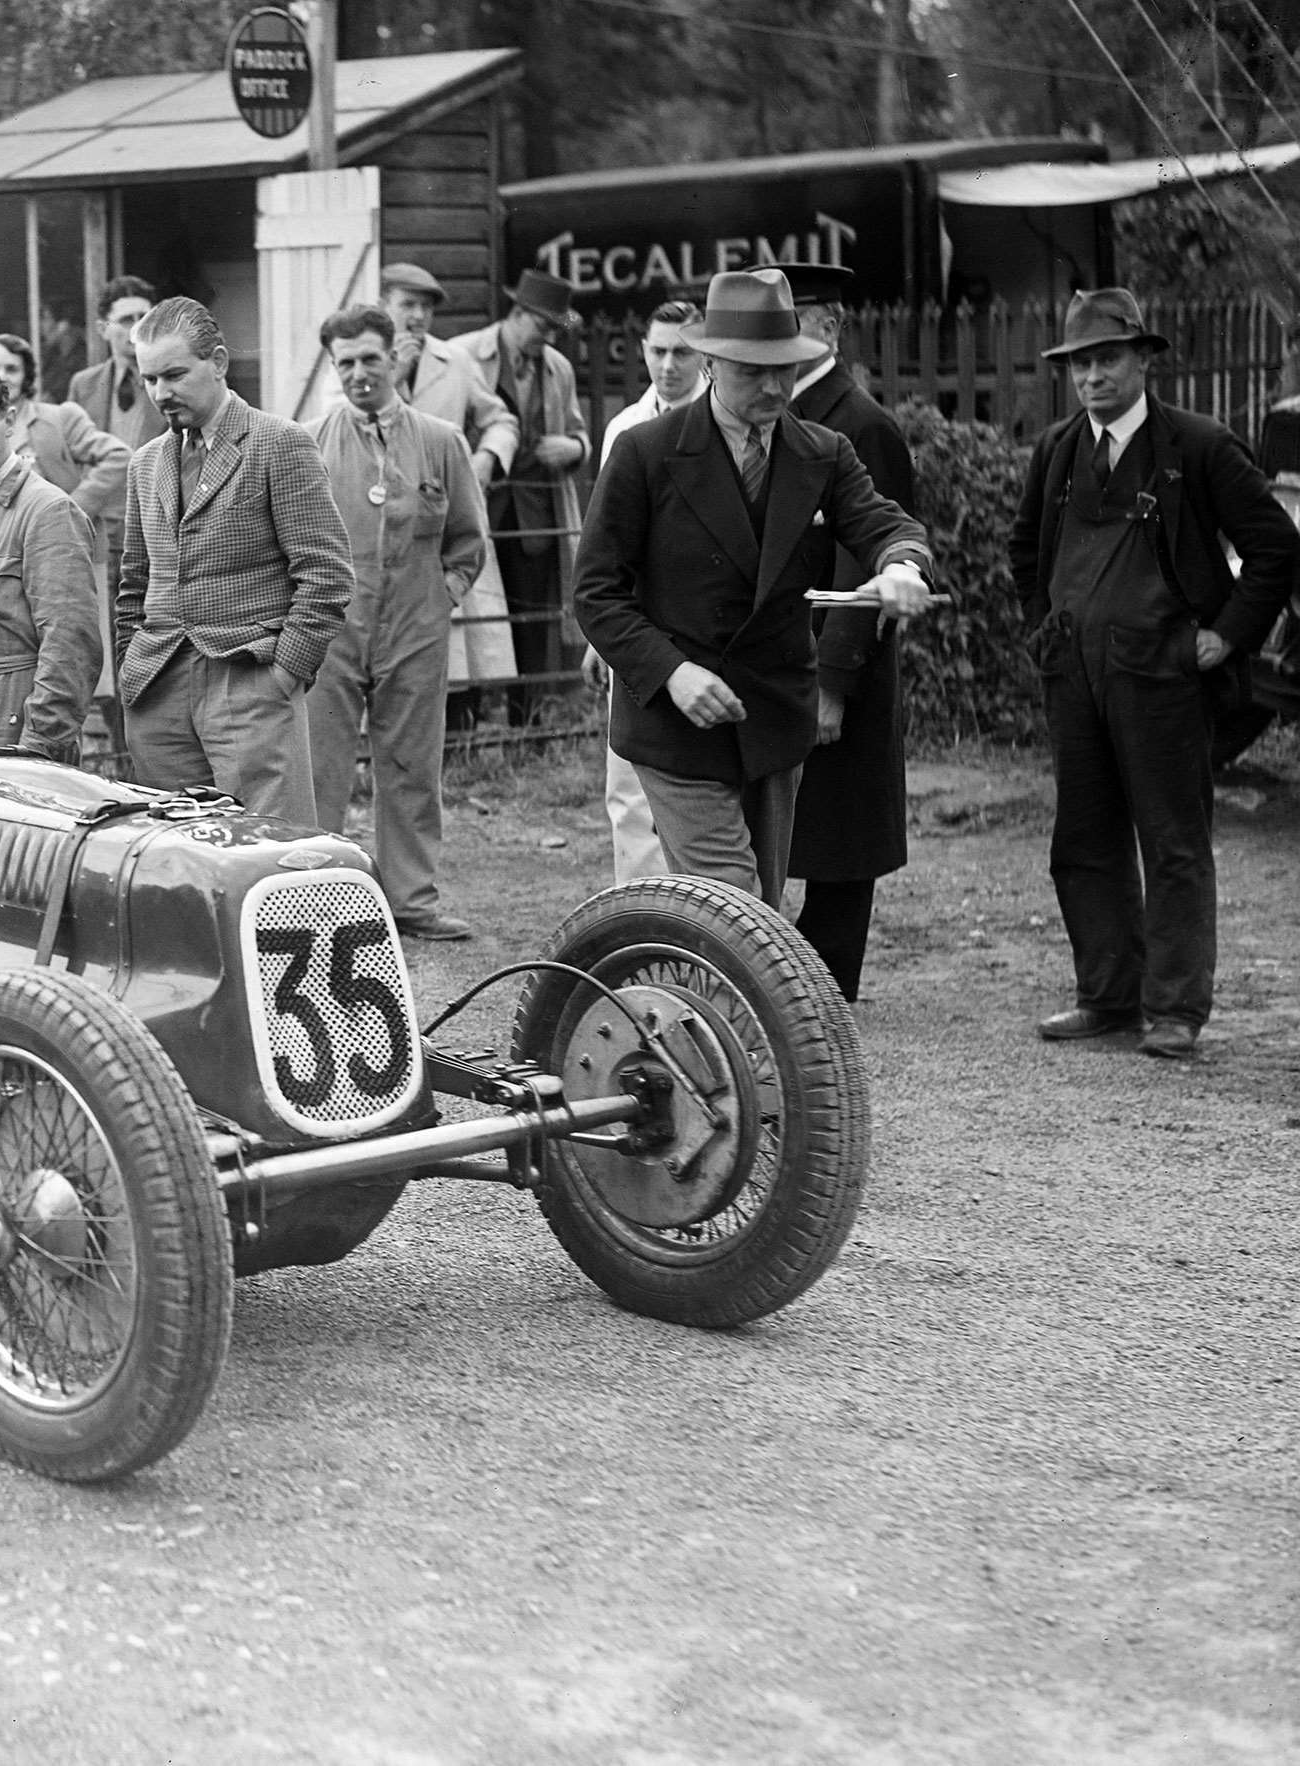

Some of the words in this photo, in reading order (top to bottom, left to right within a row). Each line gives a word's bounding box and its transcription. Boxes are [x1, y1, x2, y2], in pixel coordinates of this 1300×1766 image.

[234, 48, 307, 71] PADDOCK
[240, 78, 290, 99] OFFICE
[537, 211, 856, 290] TECALEMIT
[255, 919, 412, 1107] 35
